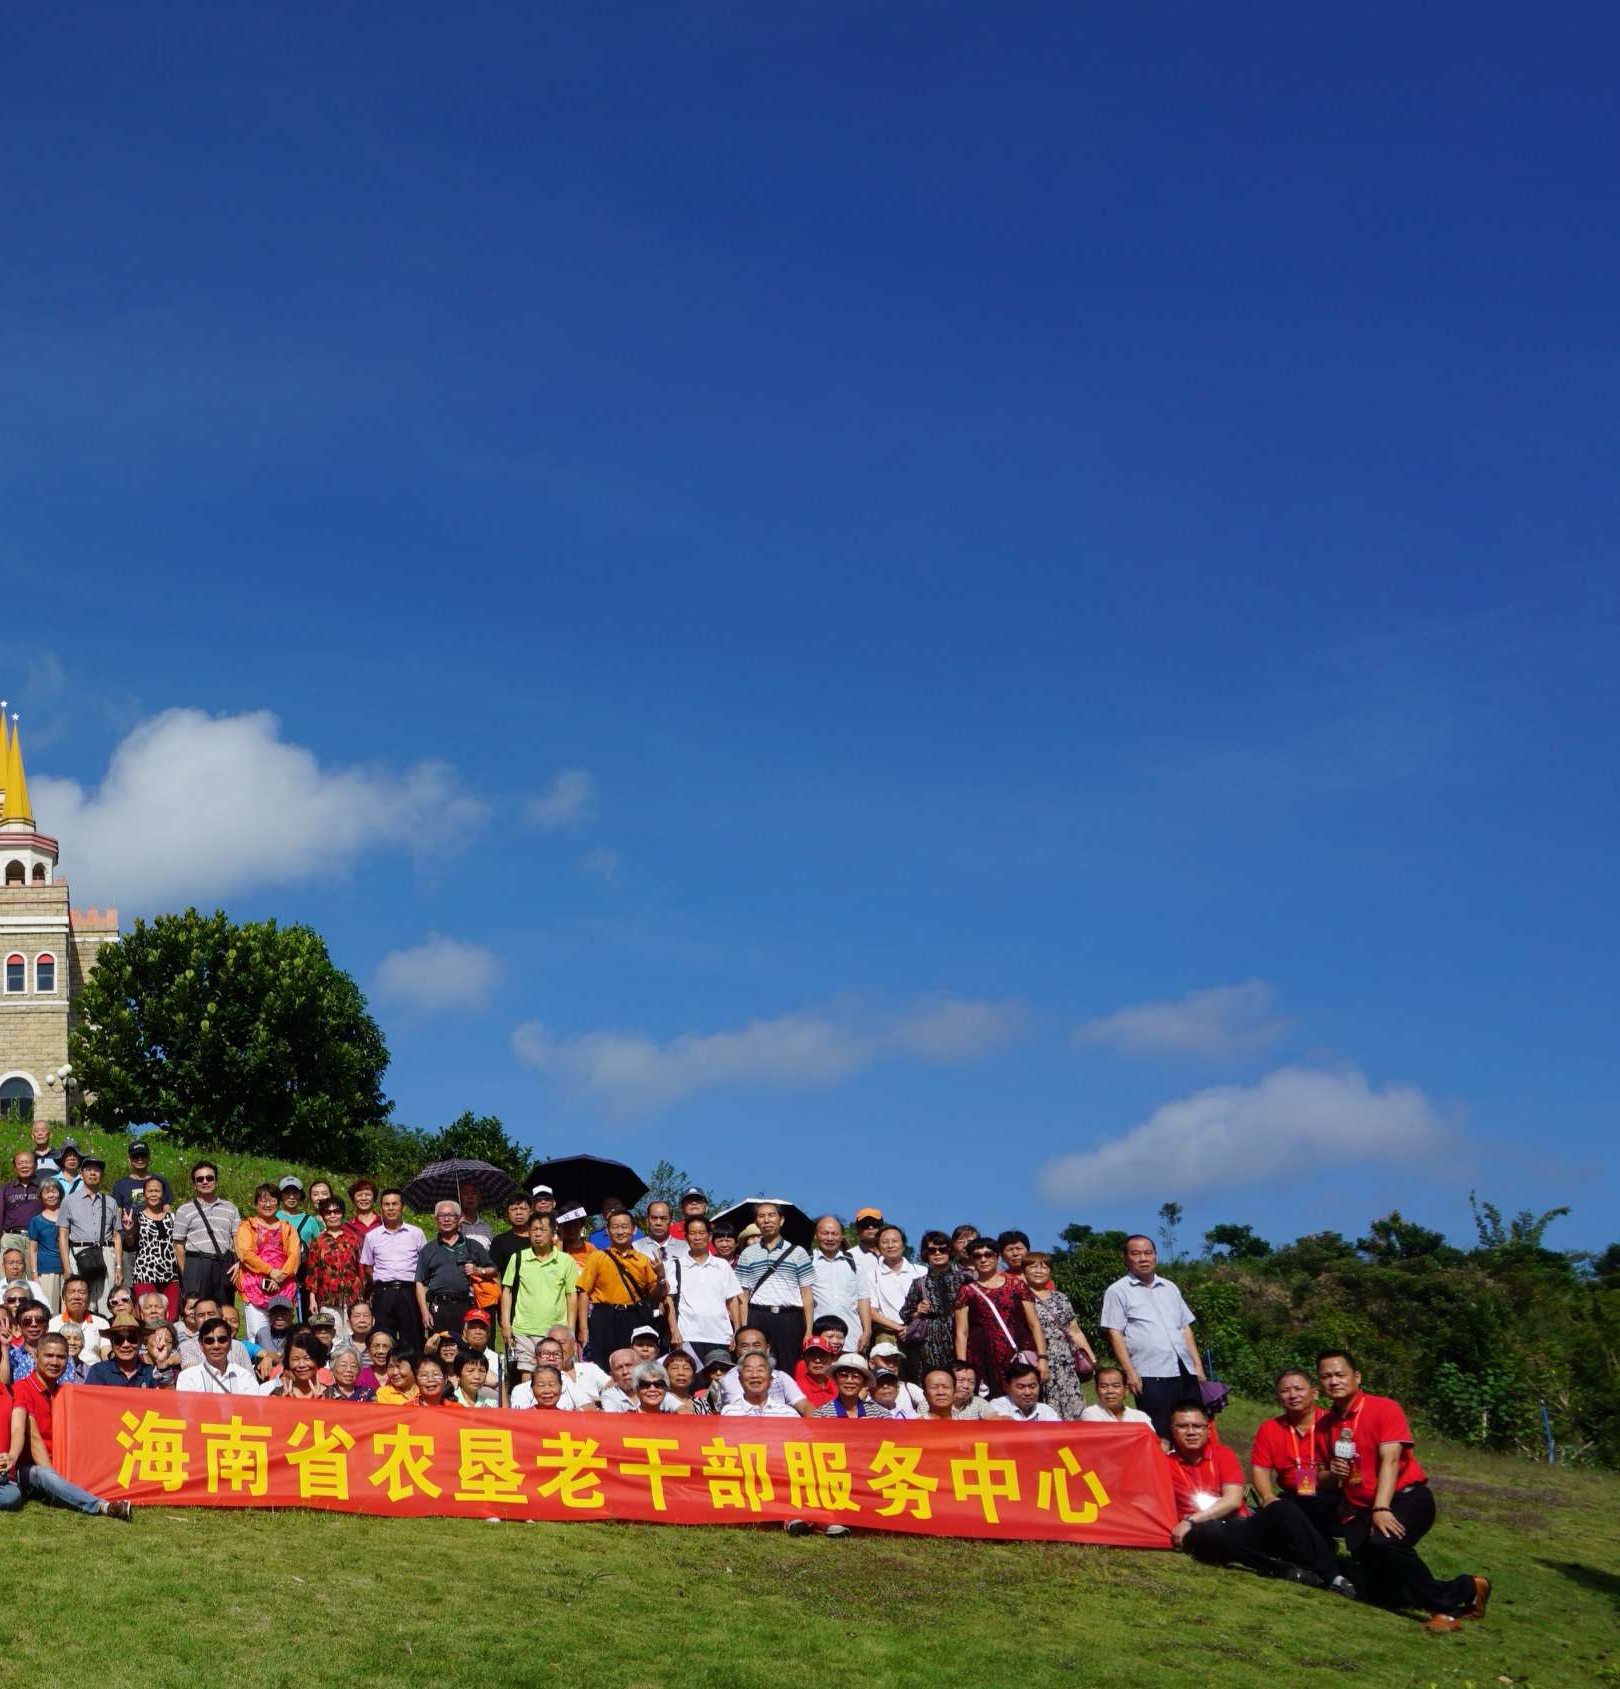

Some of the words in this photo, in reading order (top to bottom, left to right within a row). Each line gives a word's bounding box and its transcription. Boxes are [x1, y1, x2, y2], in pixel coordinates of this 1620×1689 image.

[115, 1409, 1111, 1524] 海南省农垦老干部服务中心
